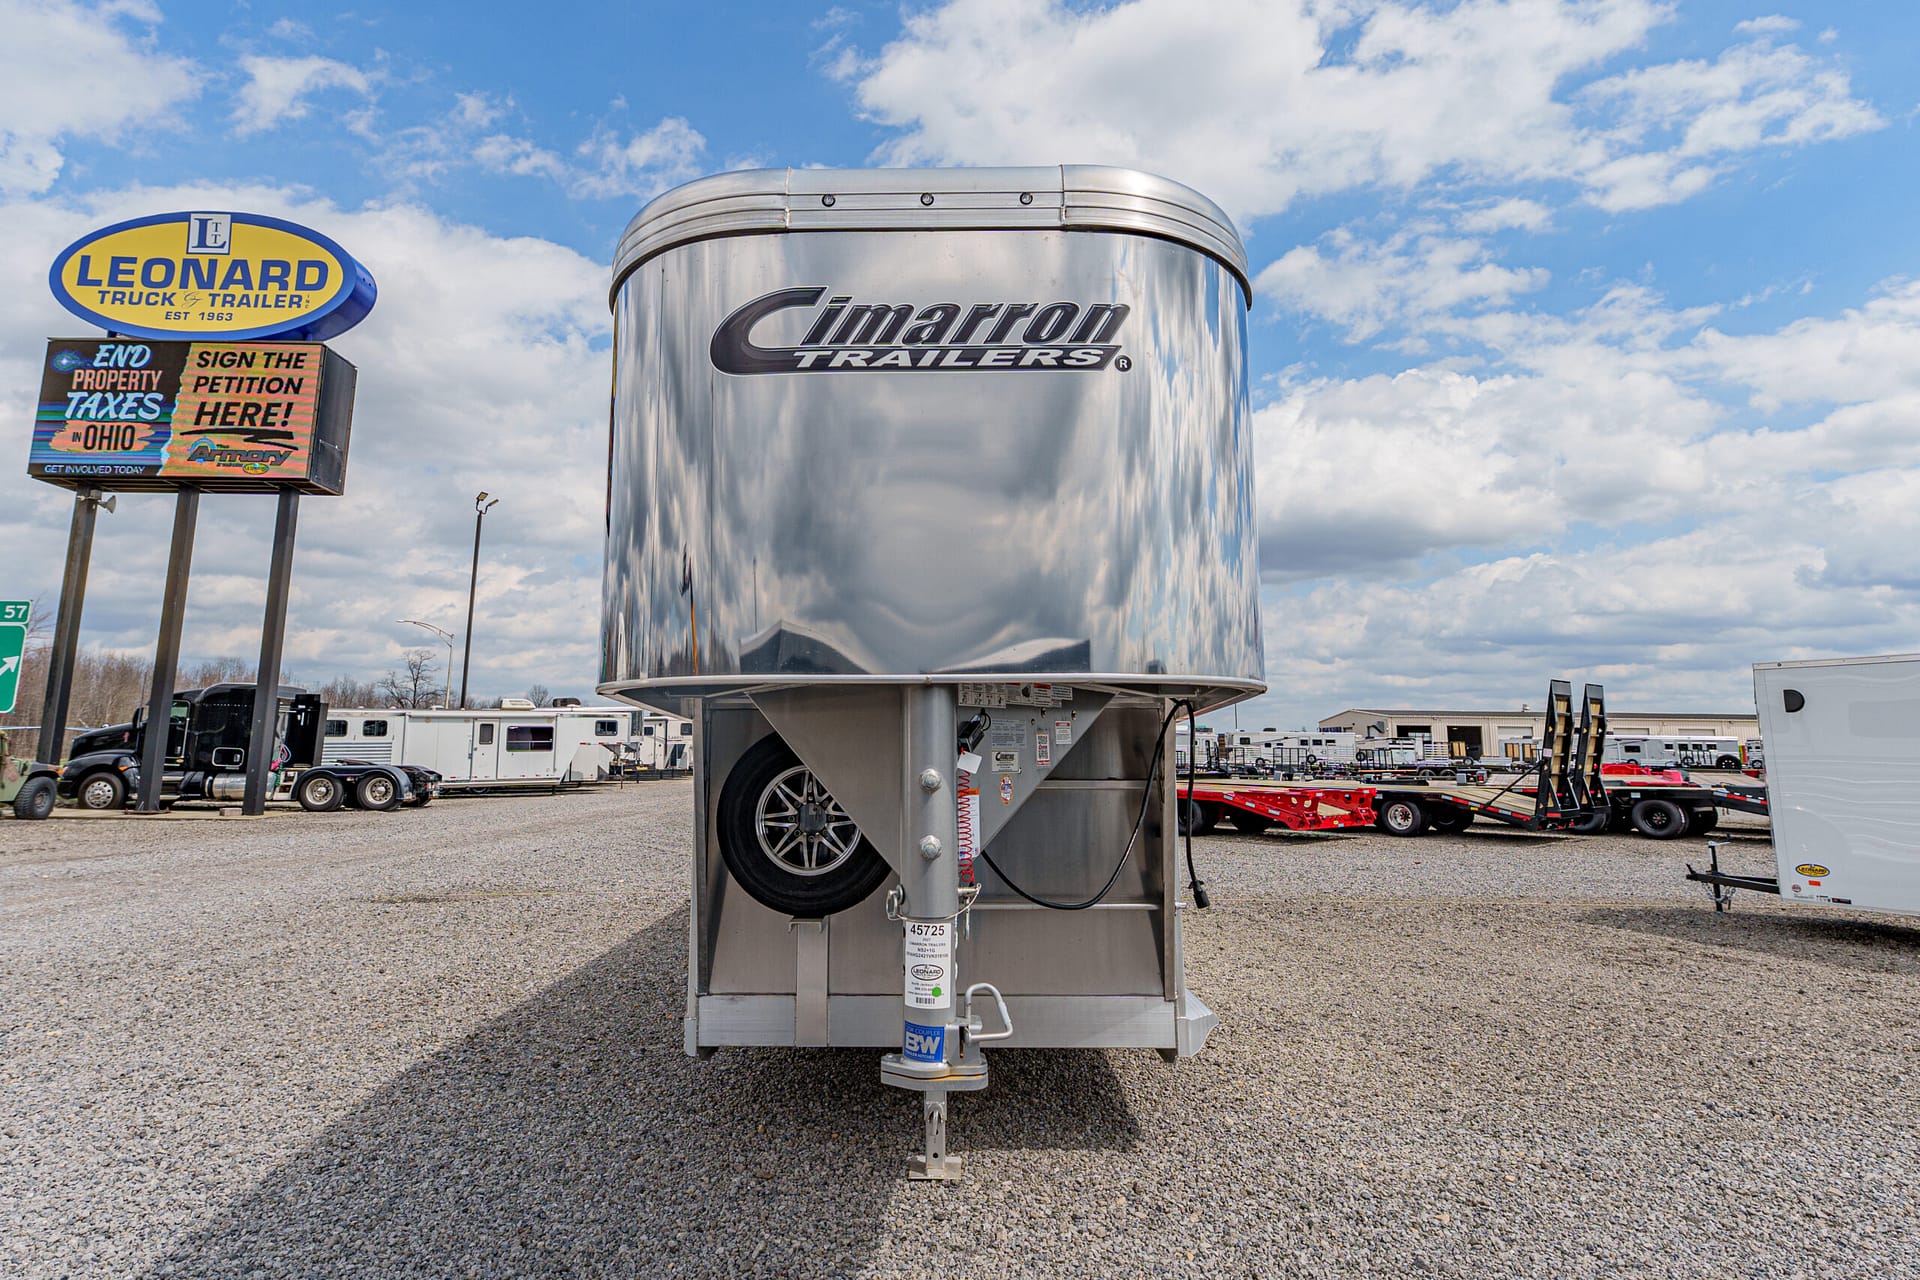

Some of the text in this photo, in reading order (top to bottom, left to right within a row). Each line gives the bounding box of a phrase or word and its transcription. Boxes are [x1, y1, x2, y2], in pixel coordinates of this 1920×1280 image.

[76, 254, 329, 292] LEONARD
[97, 290, 177, 307] TRUCK
[208, 293, 303, 309] TRAILER
[164, 311, 234, 322] EST 1963
[711, 286, 1131, 374] Cimarron
[92, 344, 152, 368] END
[196, 350, 308, 369] SIGN THE
[793, 349, 1104, 369] TRAILERS
[71, 369, 163, 391] PROPERTY
[193, 375, 304, 394] PETITION
[64, 391, 164, 420] TAXES
[193, 401, 294, 427] HERE!
[72, 424, 136, 451] IN OHIO
[187, 446, 293, 465] Armory
[44, 465, 145, 474] GET INVOLVED TODAY
[4, 605, 27, 619] 57
[910, 924, 945, 936] 45725
